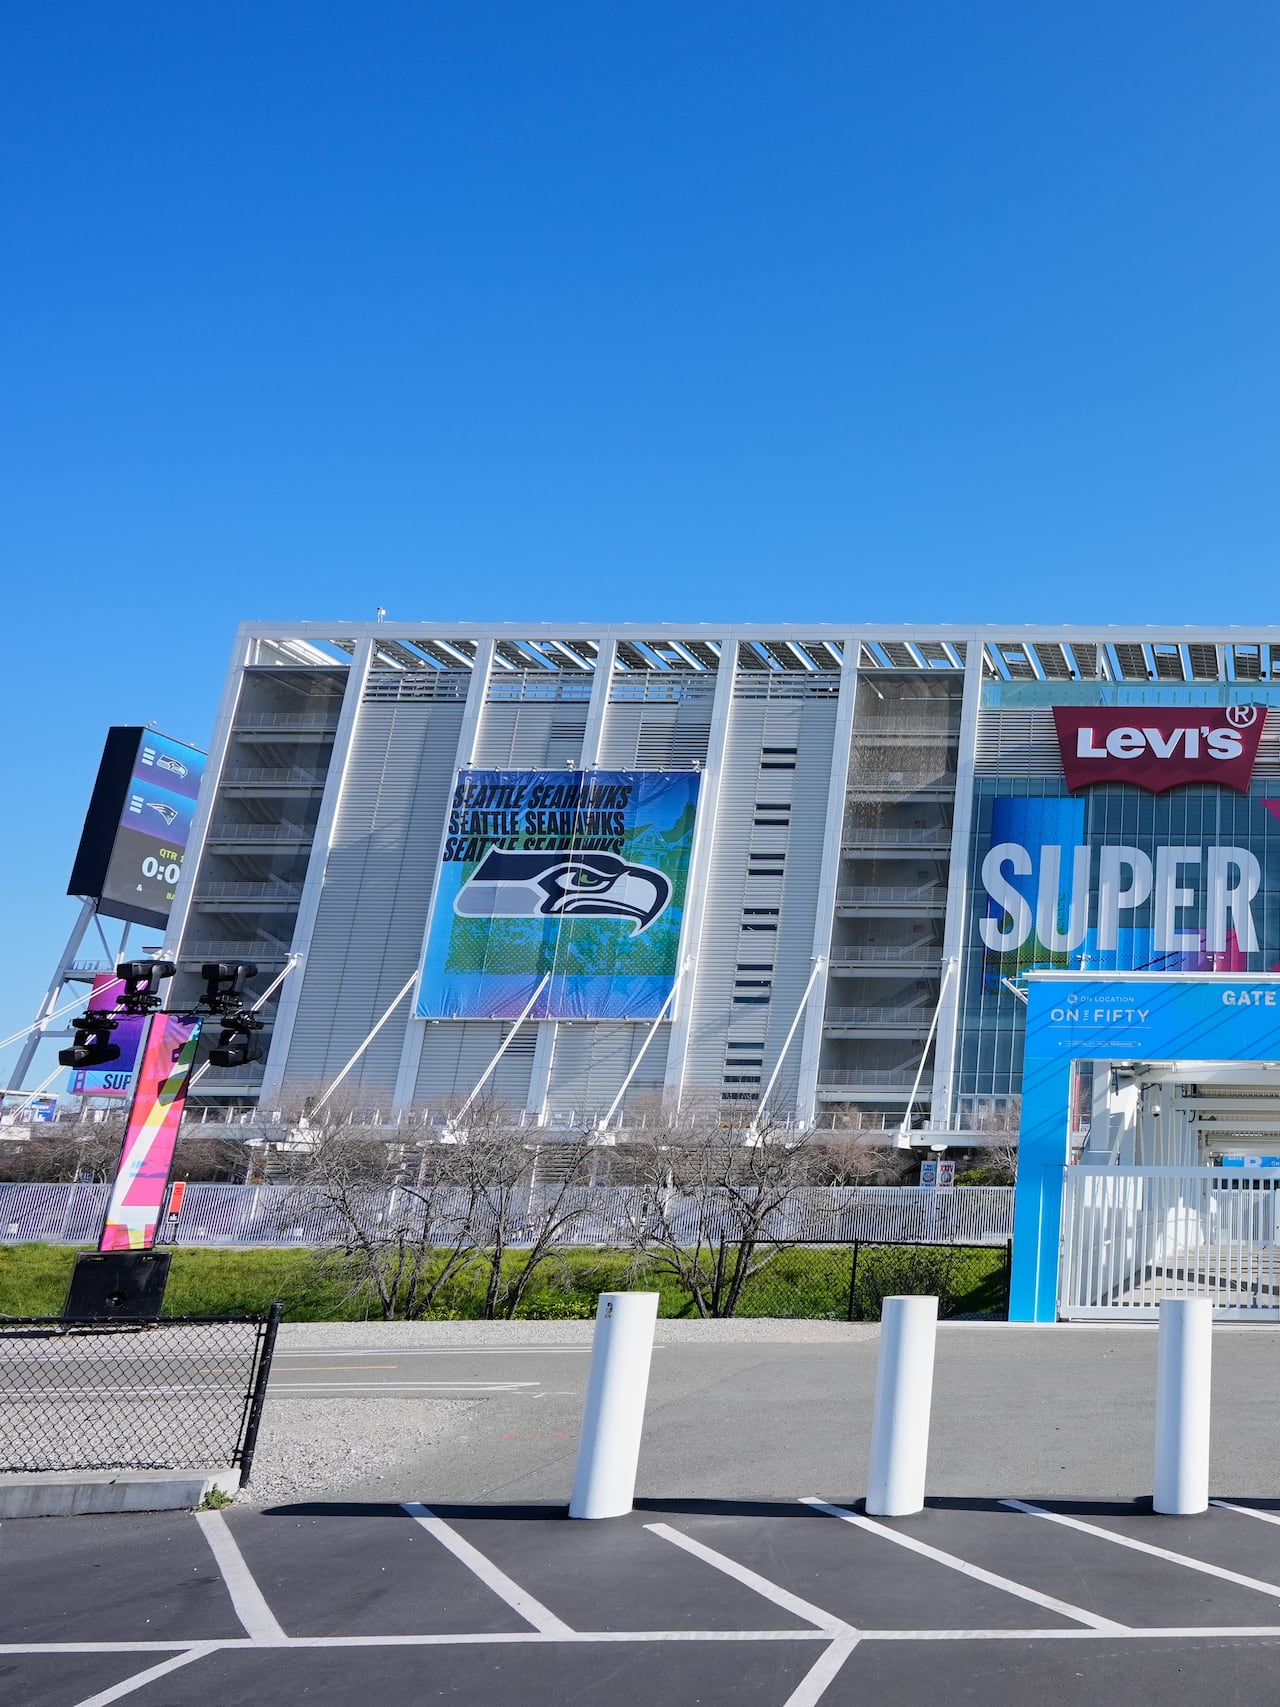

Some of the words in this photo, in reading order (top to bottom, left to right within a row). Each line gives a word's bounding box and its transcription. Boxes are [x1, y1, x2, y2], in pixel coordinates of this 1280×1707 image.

[453, 784, 528, 809] SEATTLE
[528, 784, 632, 809] SEAHAWKS
[449, 811, 520, 836] SEATTLE
[525, 811, 625, 836] SEAHAWKS
[159, 848, 178, 861] QTR
[141, 856, 180, 885] 0:0
[979, 844, 1261, 953] SUPER
[1222, 990, 1277, 1006] GATE
[1050, 1008, 1080, 1022] ON
[1094, 1009, 1150, 1023] FIFTY
[102, 1073, 132, 1090] SUP
